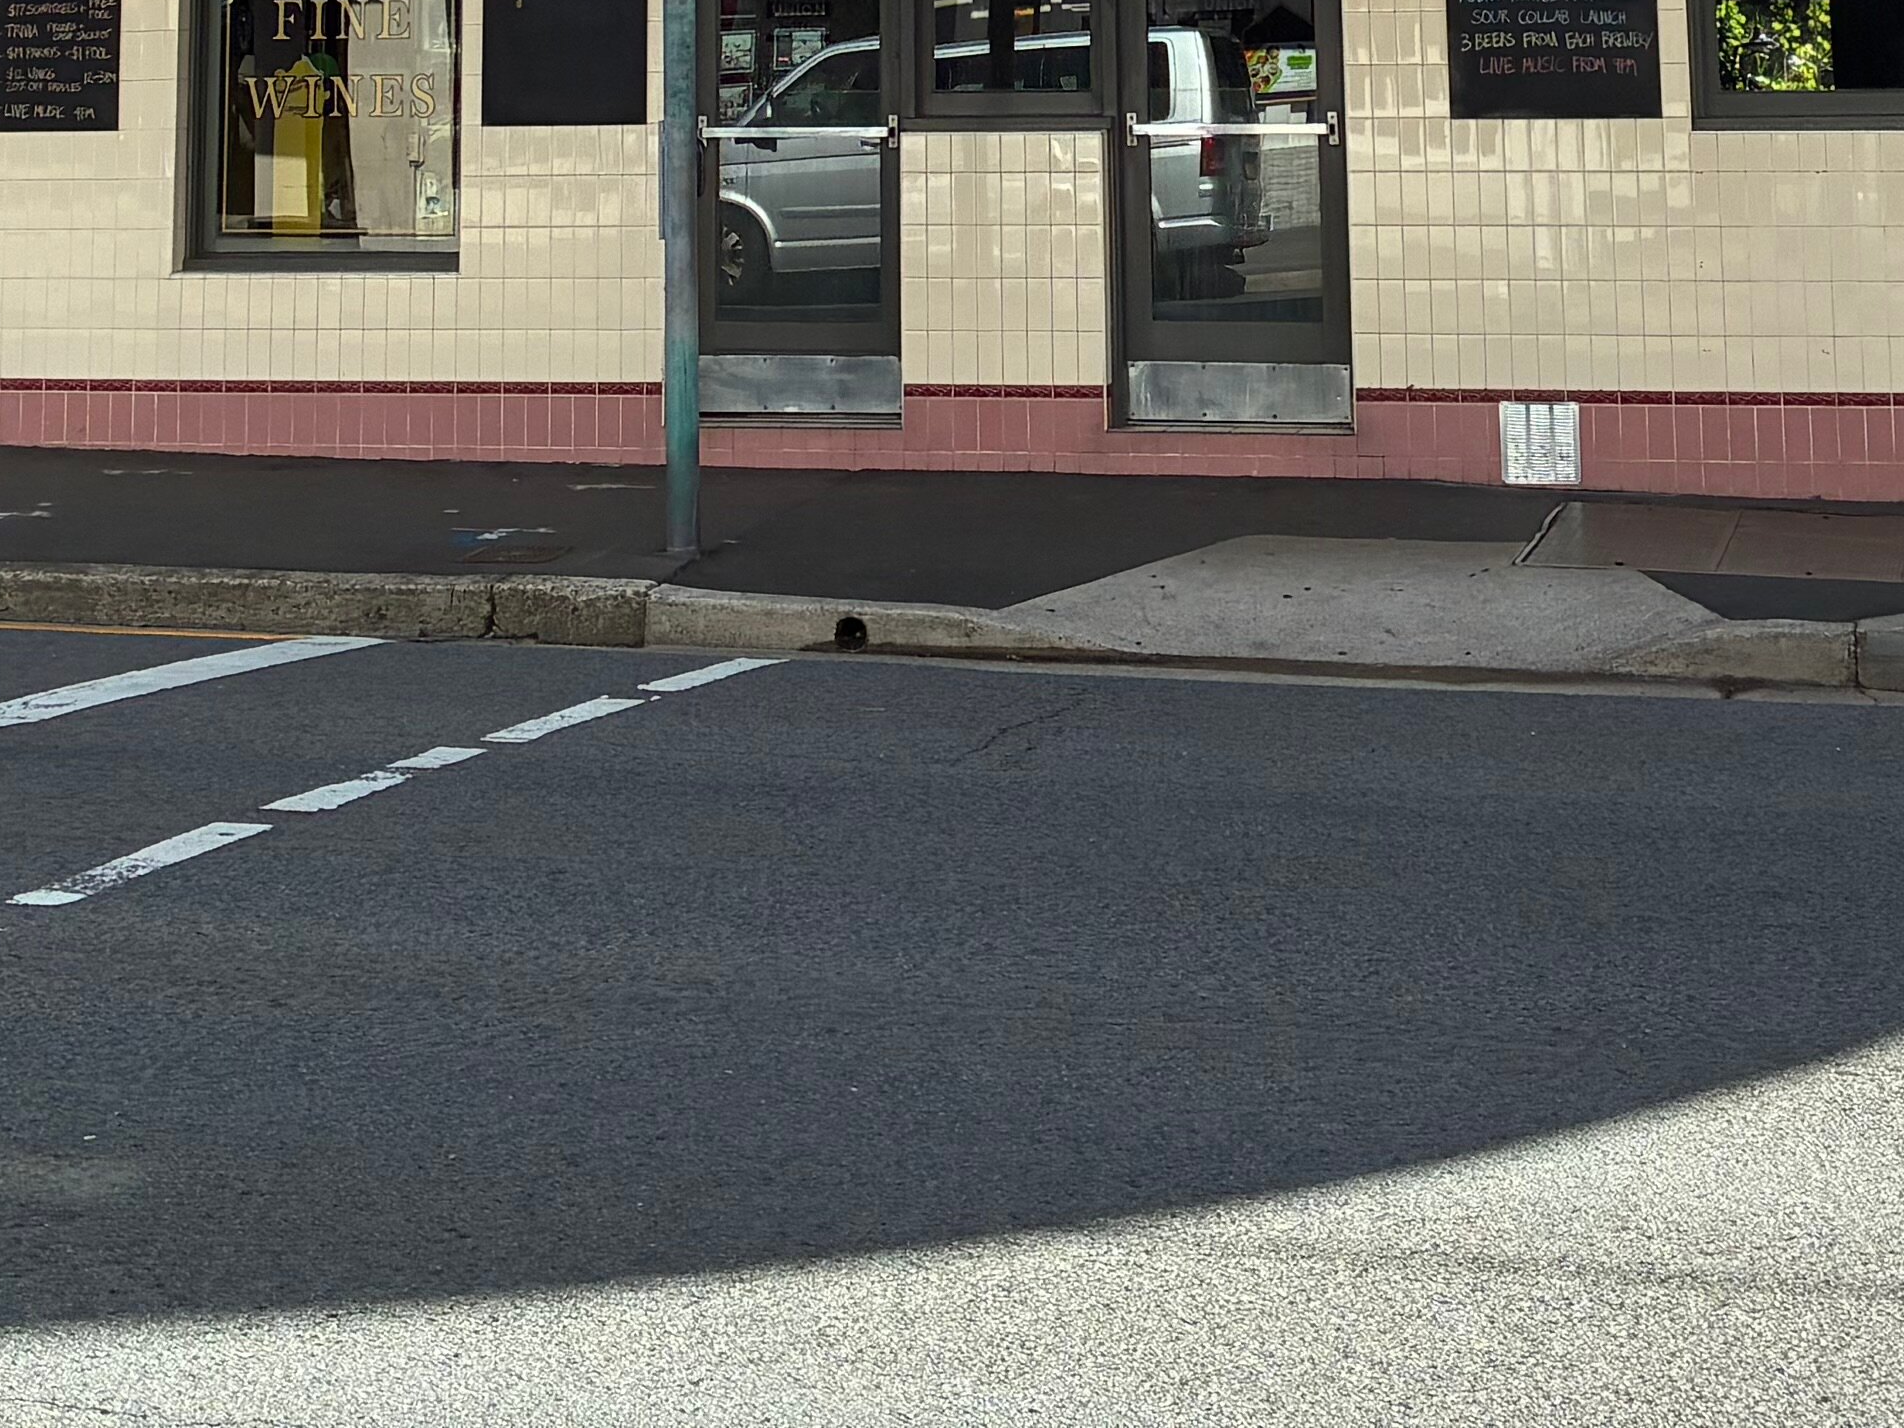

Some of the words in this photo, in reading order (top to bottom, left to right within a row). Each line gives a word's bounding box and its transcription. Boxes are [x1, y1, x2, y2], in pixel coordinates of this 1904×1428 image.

[1471, 9, 1510, 25] SOUR
[1518, 9, 1570, 25] COLLAB
[1580, 9, 1627, 25] LAUNCH
[1475, 32, 1516, 51] BEERS
[1523, 31, 1558, 48] FROM
[1479, 56, 1515, 74] LIVE
[1572, 56, 1607, 74] FROM
[244, 72, 437, 120] WINES
